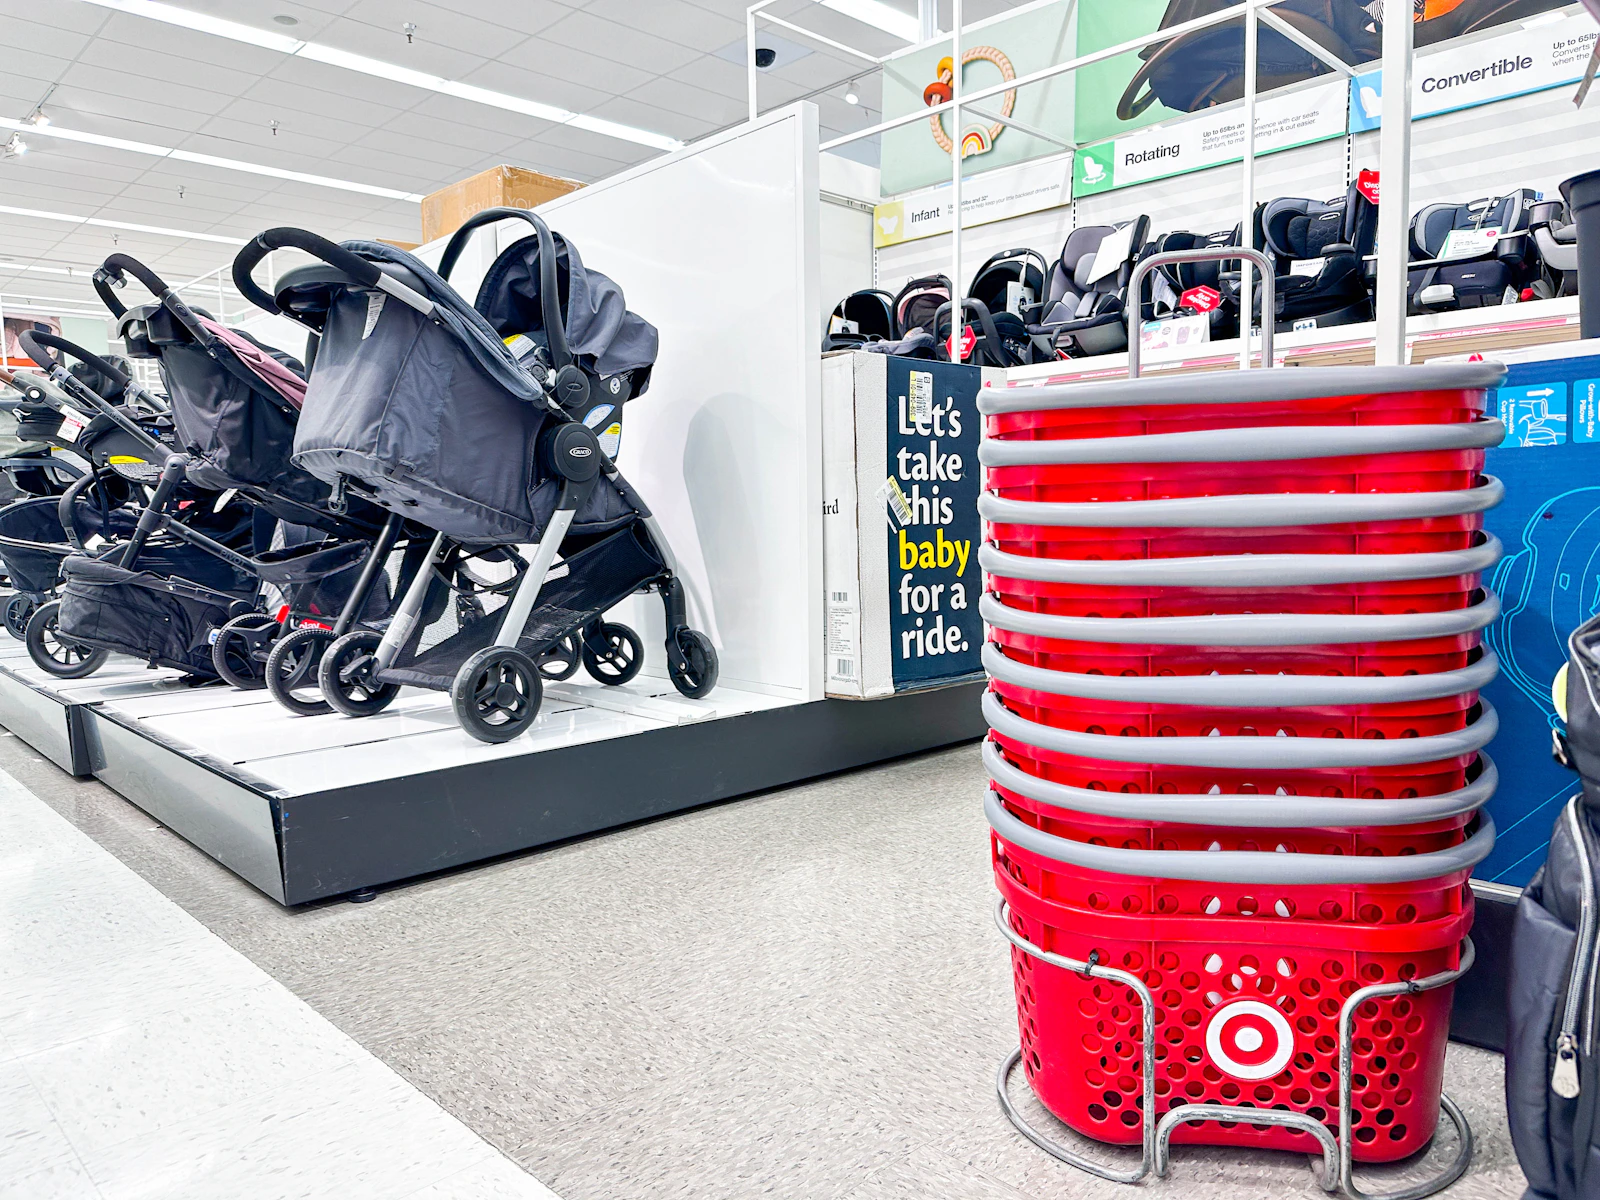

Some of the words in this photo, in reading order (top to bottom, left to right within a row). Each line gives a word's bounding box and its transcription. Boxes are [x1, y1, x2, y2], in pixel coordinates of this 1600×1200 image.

[1552, 42, 1565, 50] Up
[1552, 43, 1590, 59] Converts
[1552, 56, 1574, 67] when
[1576, 52, 1590, 61] the
[1421, 55, 1533, 94] Convertible
[1202, 136, 1220, 145] Safety
[1220, 132, 1239, 140] meets
[1278, 117, 1290, 126] with
[1291, 115, 1301, 123] car
[1302, 110, 1320, 120] seats
[1220, 124, 1236, 134] 65lbs
[1254, 130, 1272, 140] etting
[1285, 123, 1296, 131] out
[1125, 144, 1181, 166] Rotating
[911, 206, 940, 224] Infant
[1586, 383, 1596, 438] Grow-with-Baby
[896, 440, 963, 482] take
[822, 498, 839, 515] ird
[898, 528, 971, 578] baby
[898, 572, 944, 614] for
[950, 582, 968, 610] a
[902, 614, 969, 660] ride.
